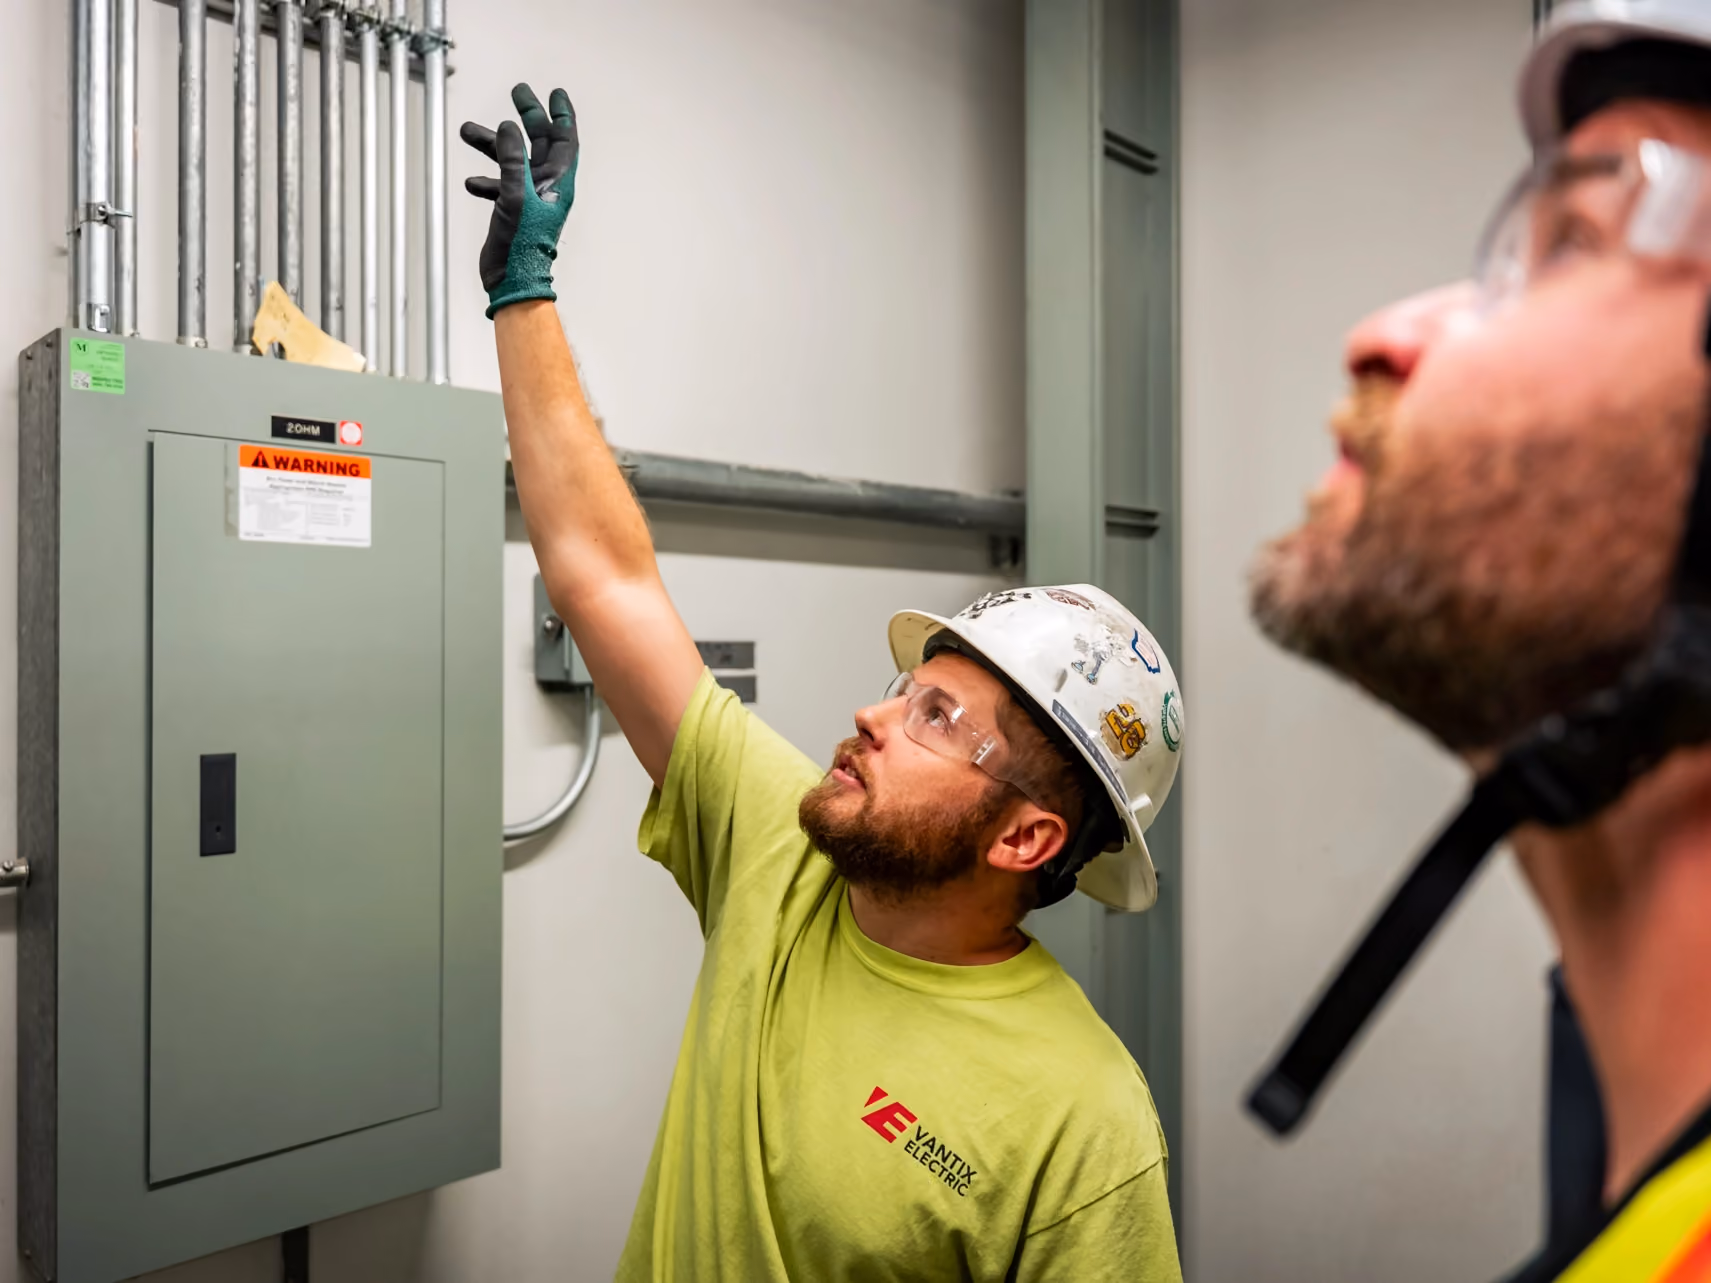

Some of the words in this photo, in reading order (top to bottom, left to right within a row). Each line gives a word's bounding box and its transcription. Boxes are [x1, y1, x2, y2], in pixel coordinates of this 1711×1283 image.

[273, 455, 361, 478] WARNING
[904, 1139, 969, 1197] ELECTRIC
[915, 1125, 977, 1185] VANTIX
